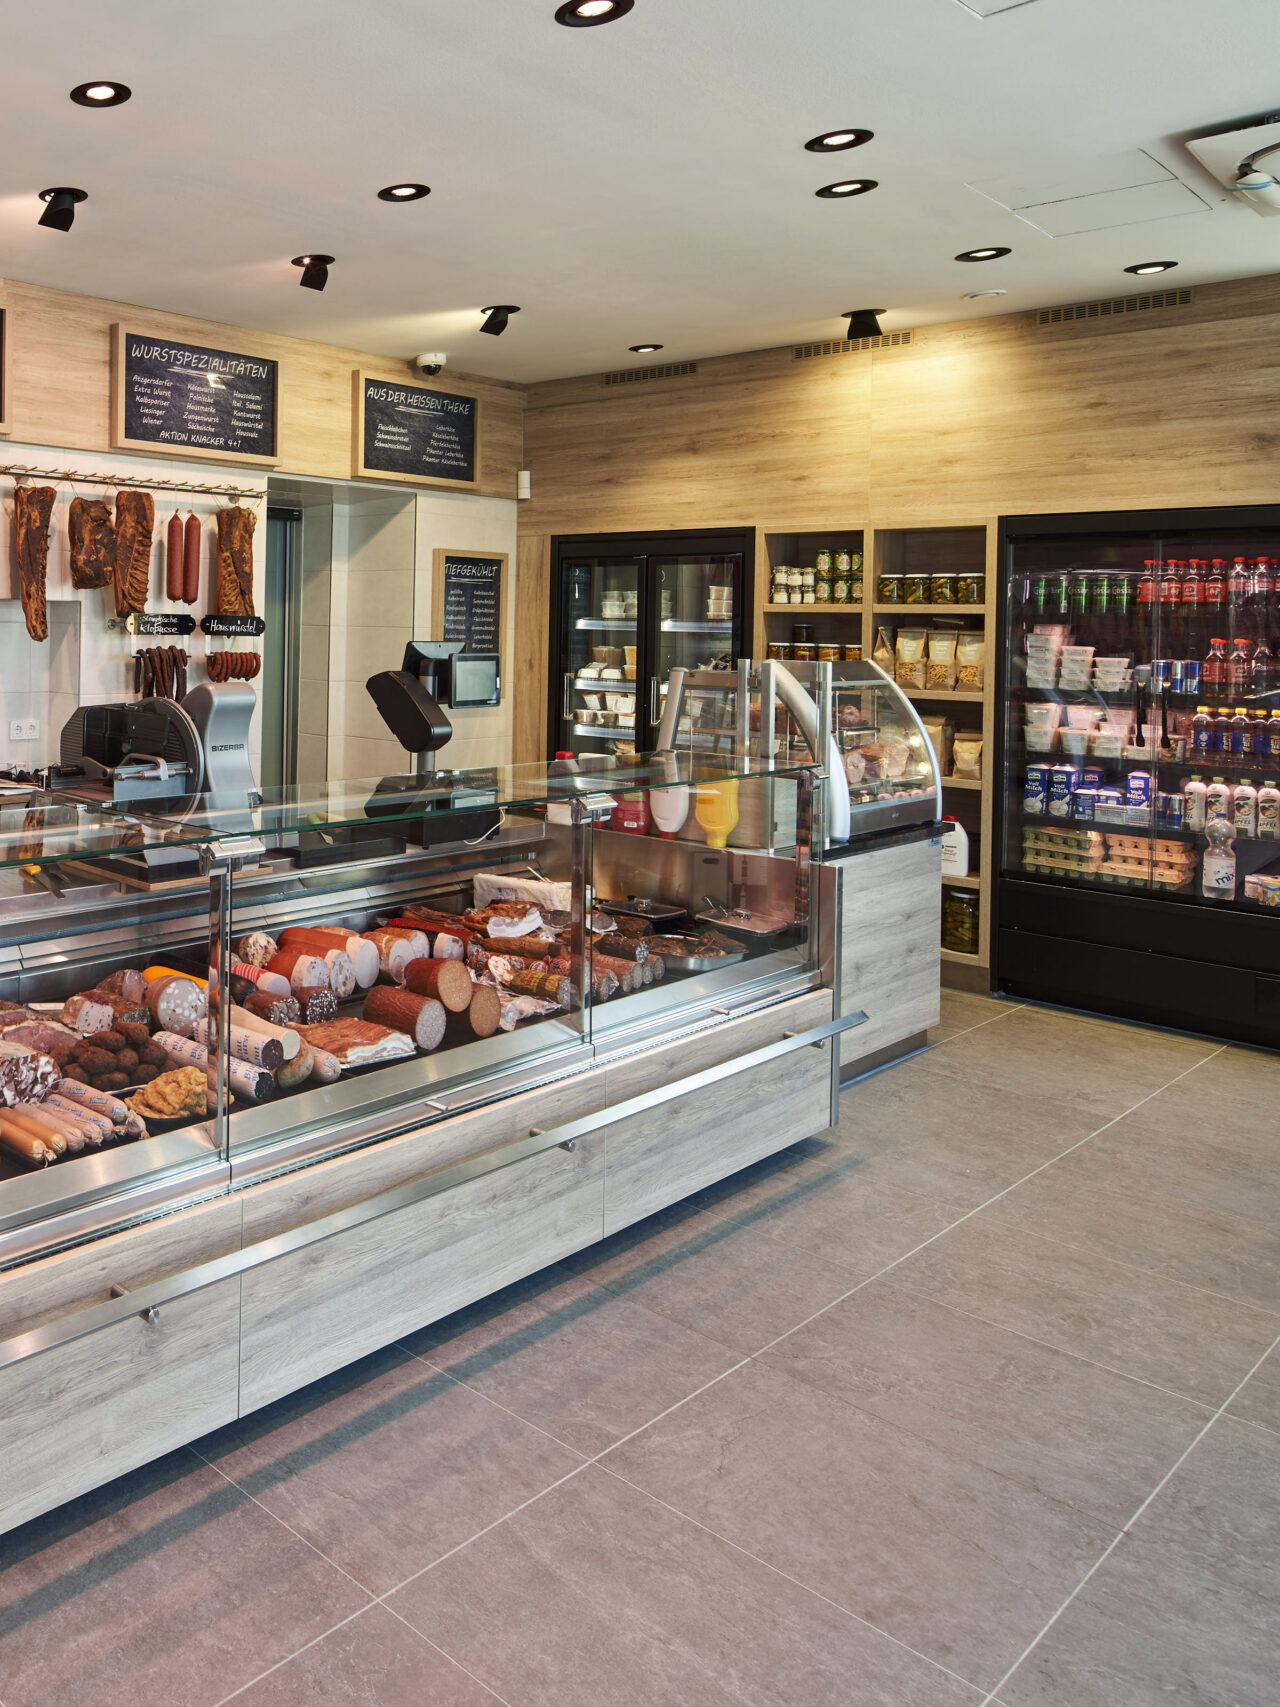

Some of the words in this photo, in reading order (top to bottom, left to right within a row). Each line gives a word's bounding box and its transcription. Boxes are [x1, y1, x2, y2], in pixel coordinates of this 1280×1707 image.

[131, 344, 268, 379] WURSTSPEZIALITÄTEN
[367, 387, 387, 400] AUS
[387, 390, 406, 404] DER
[407, 393, 441, 410] HEISSEN
[443, 400, 471, 415] THEKE
[159, 430, 188, 442] AKTION
[191, 434, 225, 446] KNACKER
[444, 563, 499, 577] TIEFGEKÜHLT
[211, 743, 245, 752] BIZERBA
